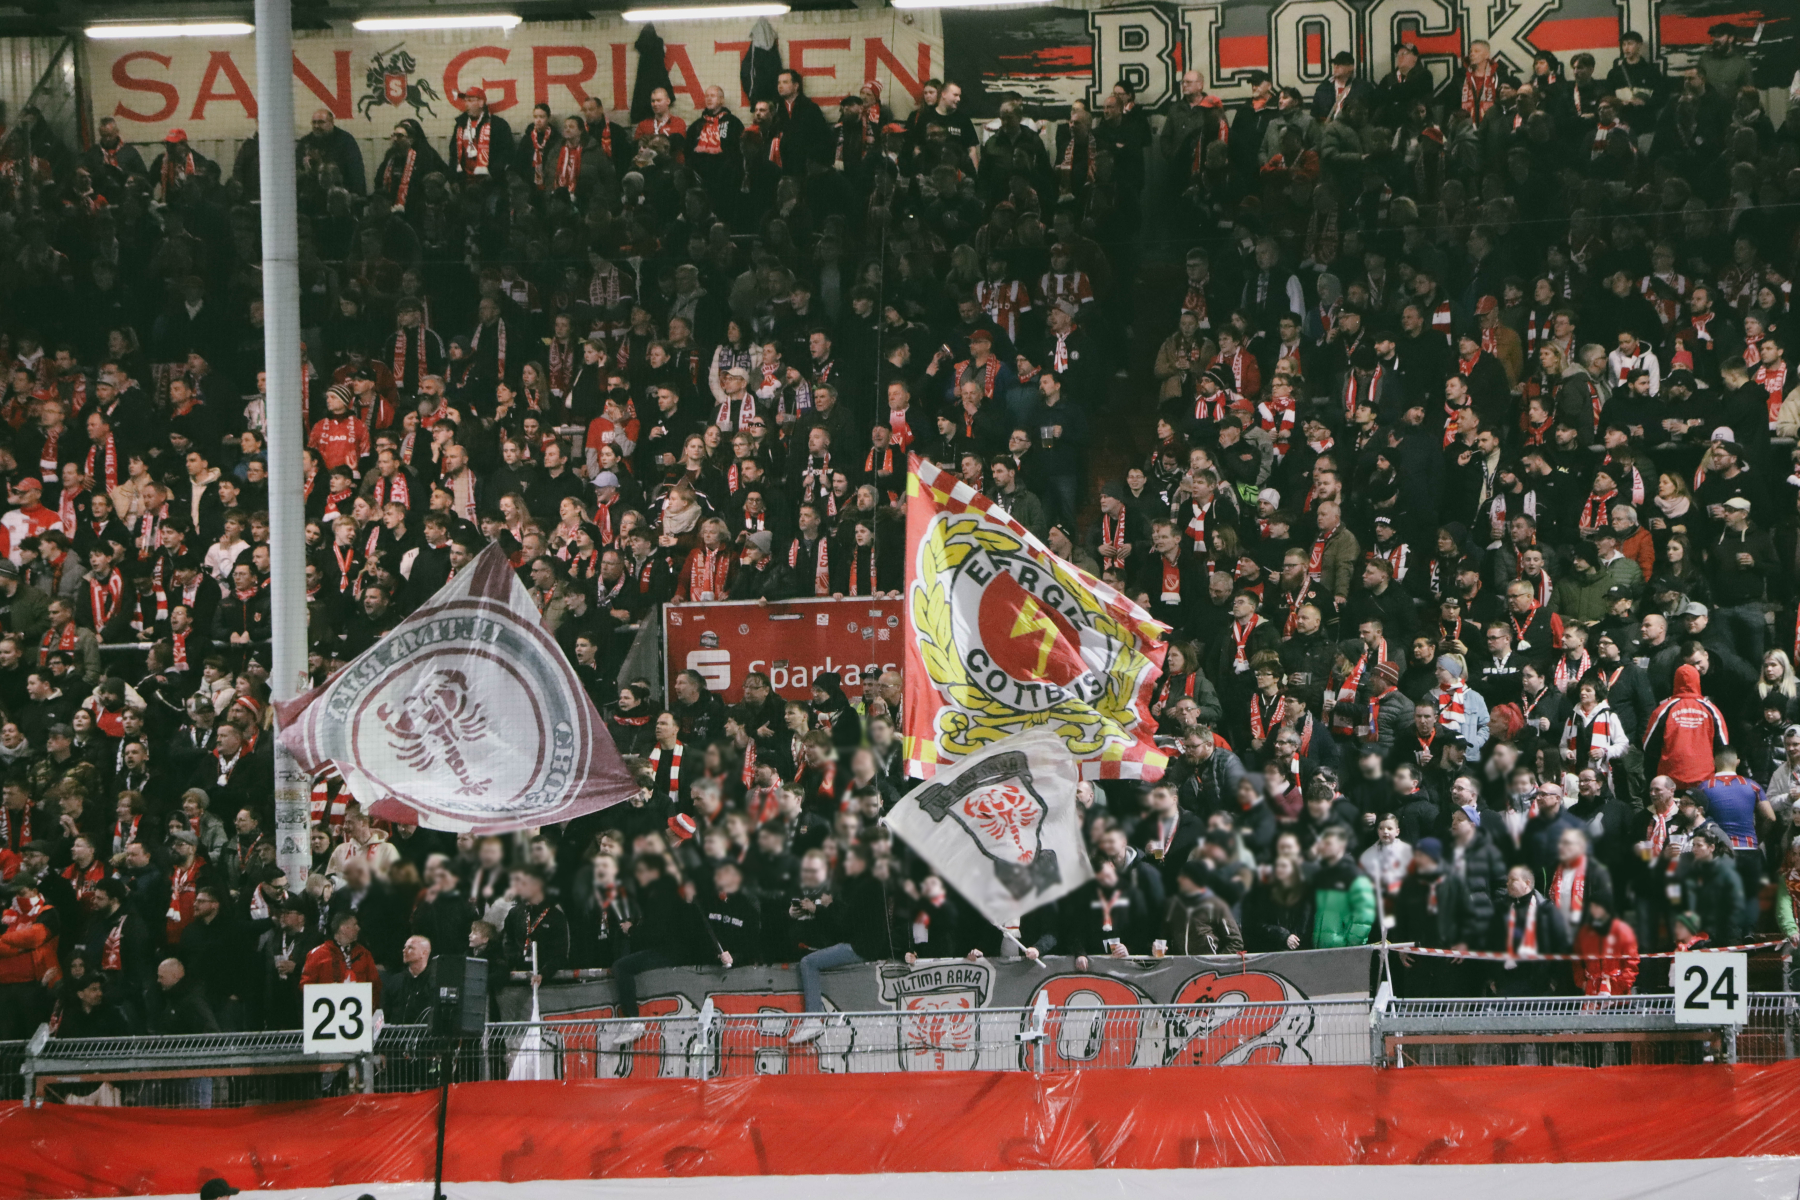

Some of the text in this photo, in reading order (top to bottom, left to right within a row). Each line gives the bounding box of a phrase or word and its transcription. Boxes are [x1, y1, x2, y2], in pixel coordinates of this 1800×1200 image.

[1088, 0, 1560, 112] BLOCK
[111, 50, 354, 123] SAN
[748, 656, 904, 693] parka
[892, 969, 983, 995] ULTIMA RAKA
[1683, 965, 1739, 1010] 24
[311, 996, 364, 1040] 23
